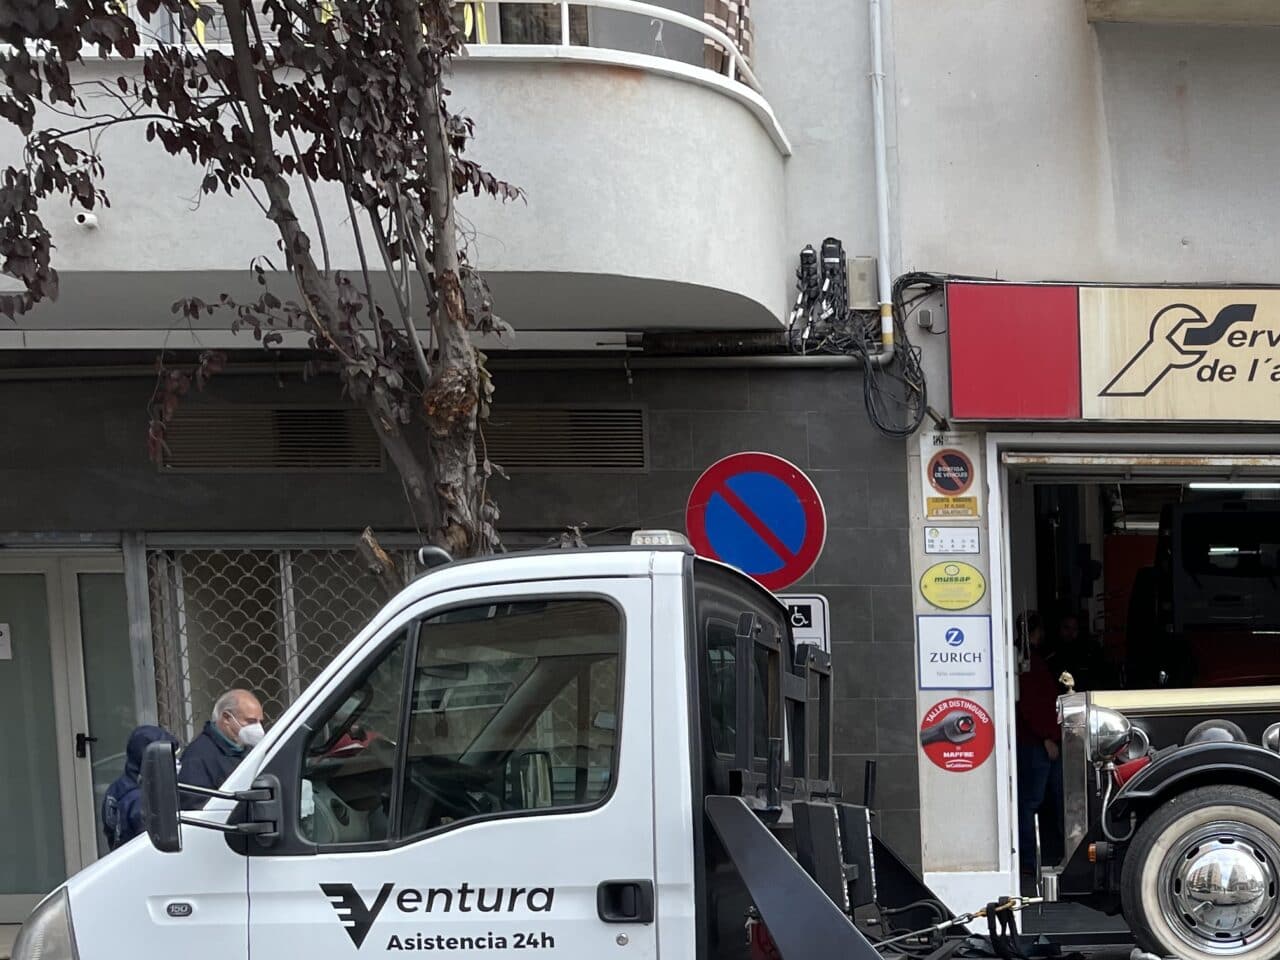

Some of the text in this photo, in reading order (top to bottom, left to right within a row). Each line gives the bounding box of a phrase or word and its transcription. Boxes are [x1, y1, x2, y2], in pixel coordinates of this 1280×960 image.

[1197, 357, 1237, 382] de
[930, 652, 982, 663] ZURICH
[926, 700, 989, 724] TALLER DISTINGUIDO
[318, 882, 555, 950] Ventura
[386, 931, 555, 950] Asistencia 24h
